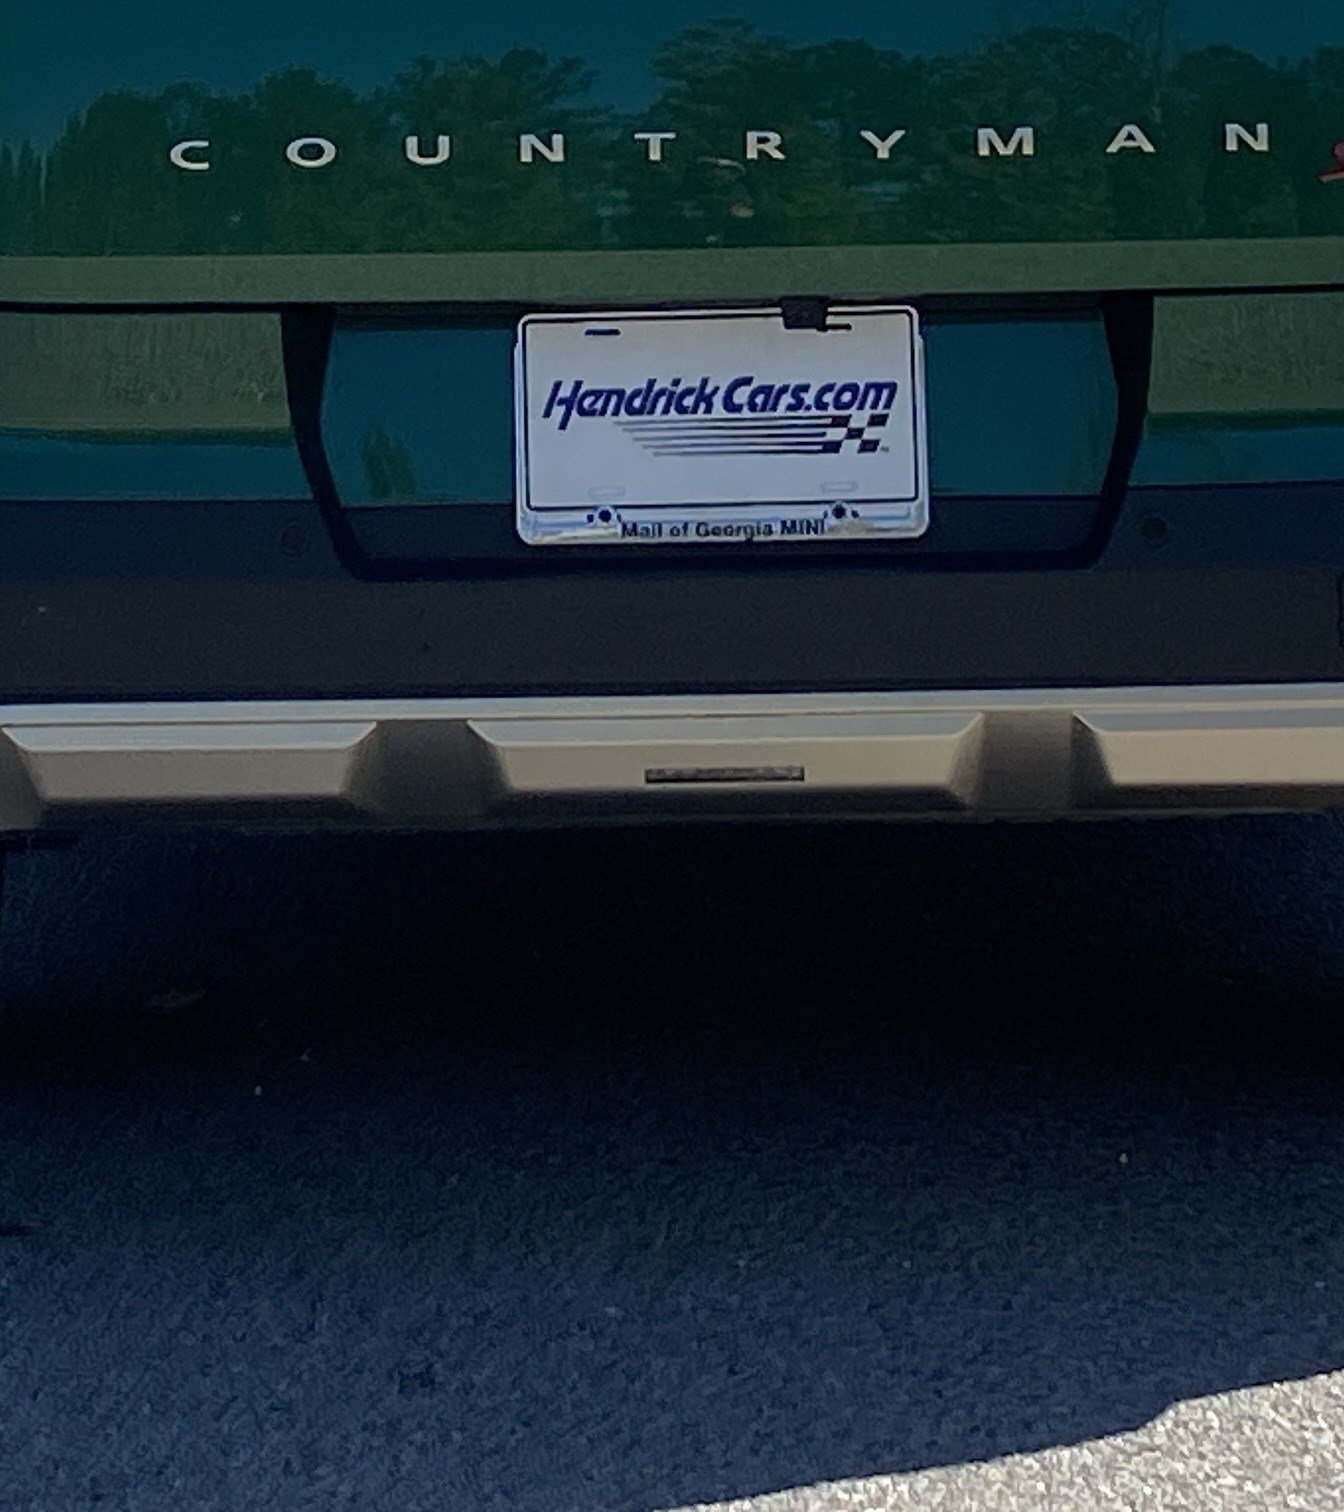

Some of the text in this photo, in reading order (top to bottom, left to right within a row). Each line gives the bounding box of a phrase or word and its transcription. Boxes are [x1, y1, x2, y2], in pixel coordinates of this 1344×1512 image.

[169, 122, 1270, 171] COUNTRYMAN
[620, 518, 826, 542] Mall of Georgia MINI
